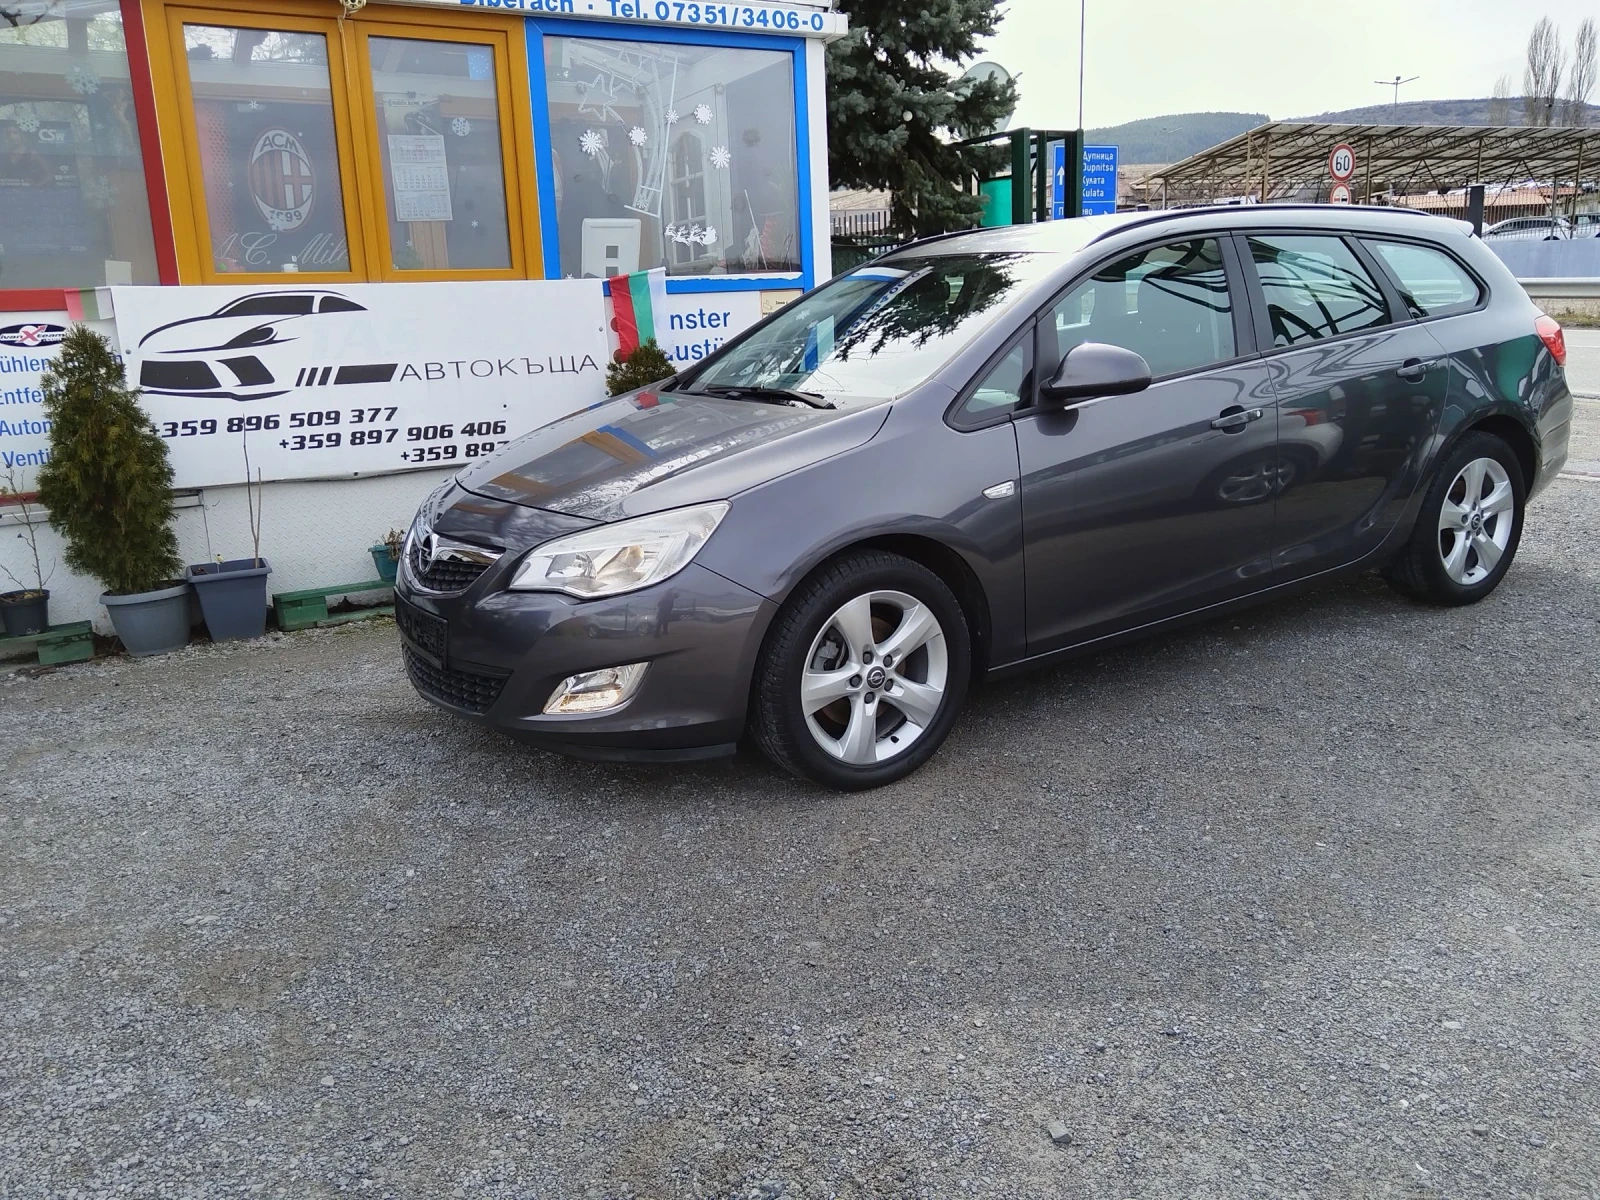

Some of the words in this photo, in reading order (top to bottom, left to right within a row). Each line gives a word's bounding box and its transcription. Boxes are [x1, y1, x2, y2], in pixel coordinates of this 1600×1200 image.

[655, 1, 824, 31] 07351/3406-0
[260, 133, 300, 154] ACM
[1083, 151, 1113, 162] Дупница
[1336, 155, 1350, 171] 60
[296, 232, 350, 265] Mil
[669, 308, 731, 330] nster
[399, 354, 599, 382] АВТОКЪЩА
[149, 419, 218, 438] +359
[226, 414, 280, 433] 896
[289, 410, 341, 428] 509
[349, 406, 398, 424] 377
[279, 432, 342, 450] +359
[350, 428, 399, 446] 897
[407, 424, 454, 442] 906
[461, 420, 507, 437] 406
[400, 445, 458, 463] +359
